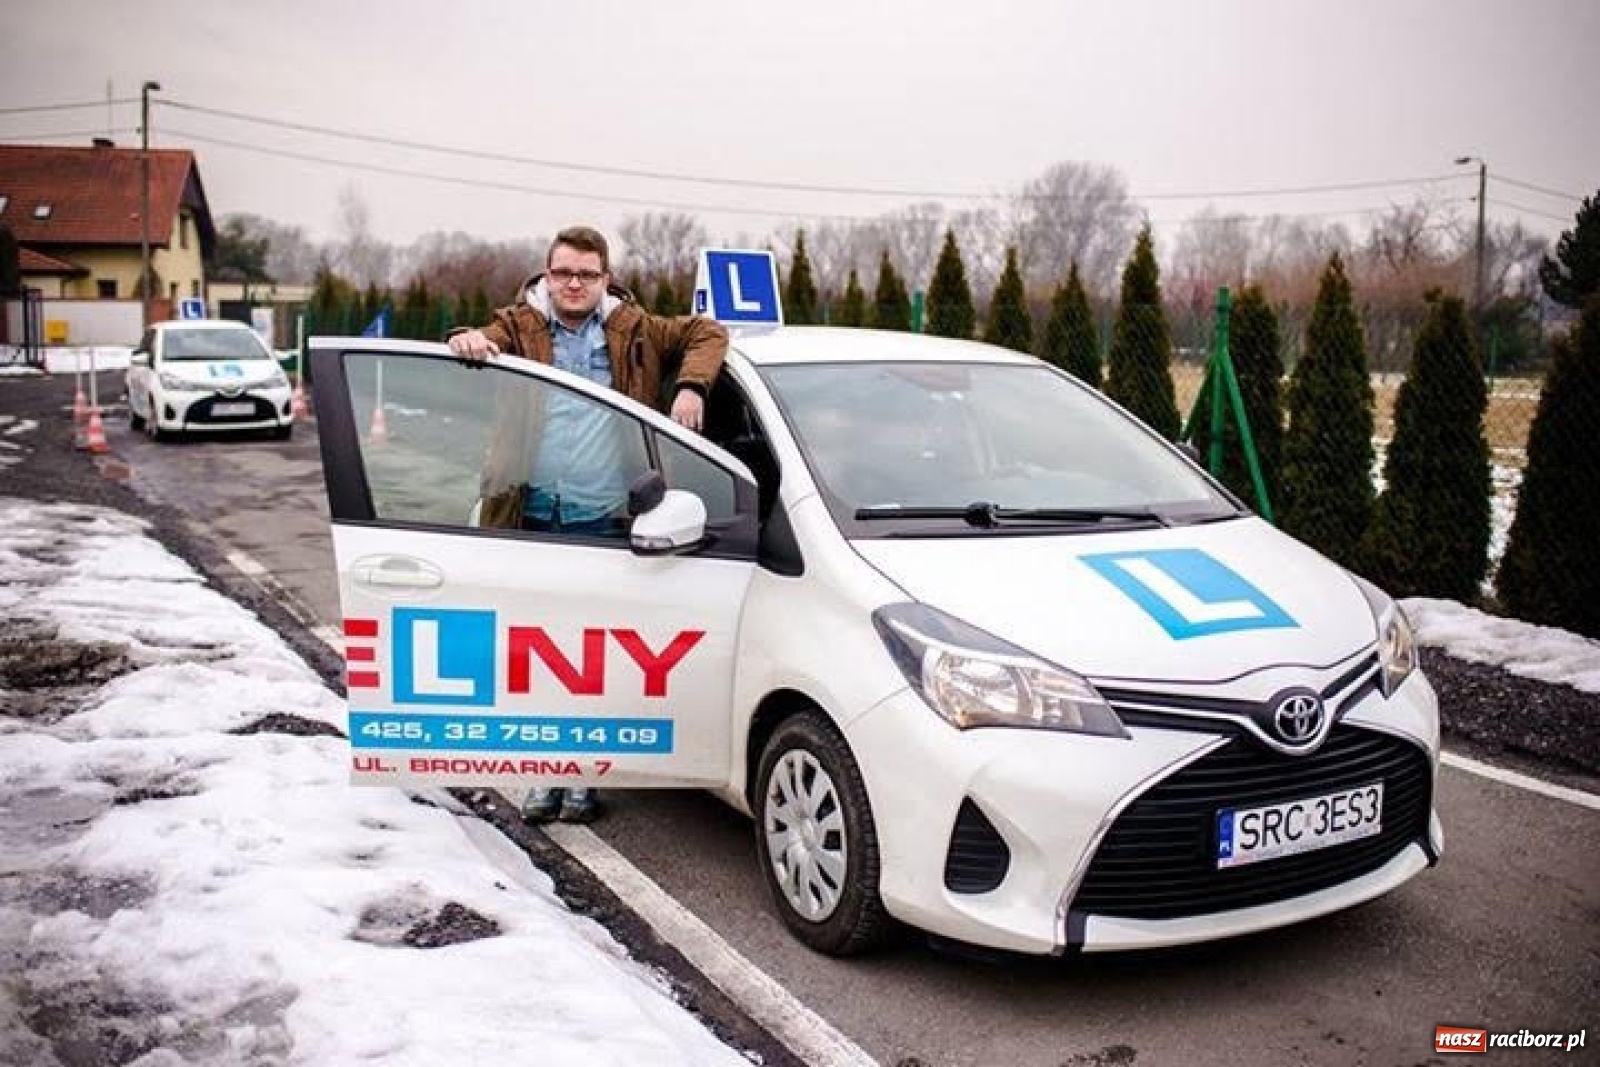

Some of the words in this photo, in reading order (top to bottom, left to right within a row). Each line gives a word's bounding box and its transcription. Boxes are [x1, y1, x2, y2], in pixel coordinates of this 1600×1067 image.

[728, 261, 761, 312] L
[1111, 557, 1266, 624] L
[361, 720, 432, 743] 425,
[444, 722, 487, 741] 32
[499, 724, 559, 743] 755
[569, 725, 607, 744] 14
[617, 726, 658, 744] 09
[353, 757, 397, 773] UL.
[409, 758, 582, 776] BROWARNA
[595, 761, 612, 776] 7
[1239, 804, 1304, 850] SRC
[1313, 788, 1379, 836] 3ES3
